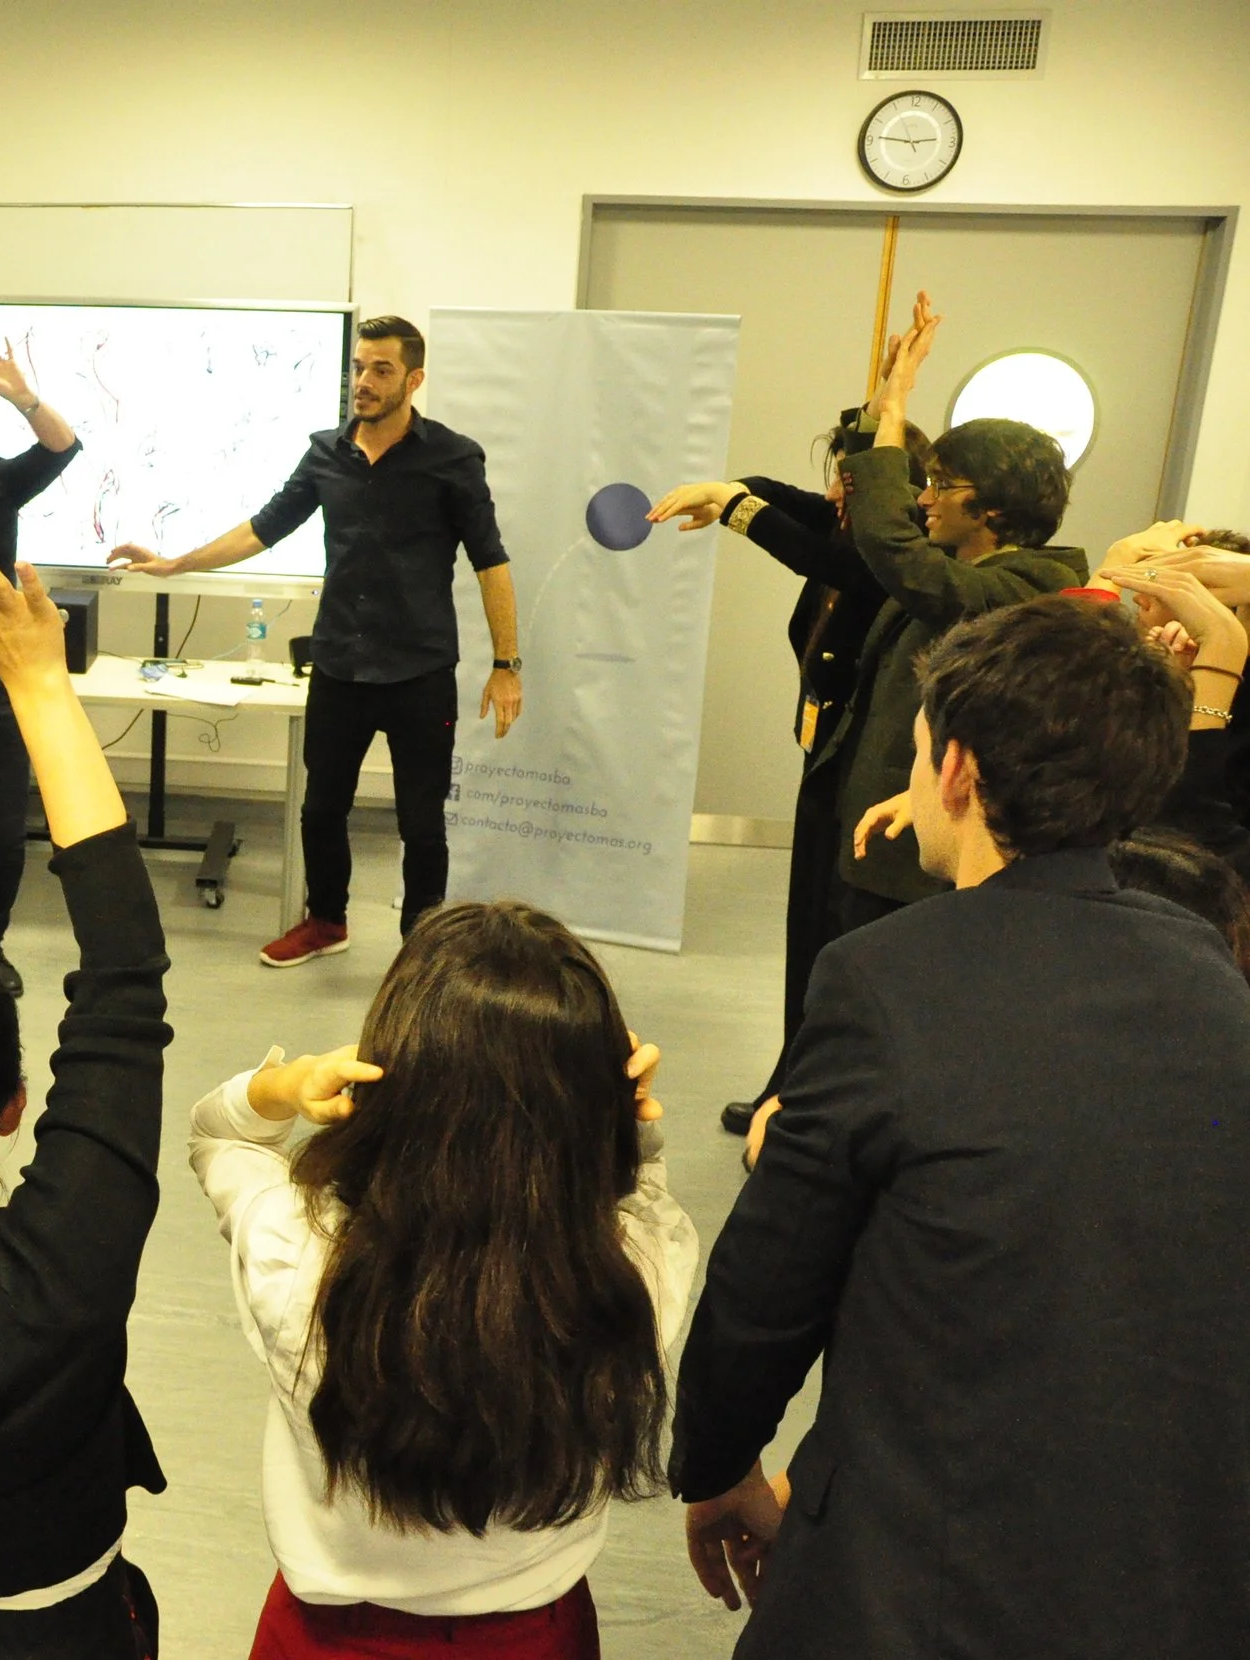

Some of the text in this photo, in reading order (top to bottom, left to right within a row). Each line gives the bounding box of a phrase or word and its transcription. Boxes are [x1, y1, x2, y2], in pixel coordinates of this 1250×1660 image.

[911, 96, 921, 107] 12
[866, 135, 874, 147] 9
[949, 137, 956, 148] 3
[902, 174, 910, 186] 6
[464, 762, 571, 785] proyectomasba
[460, 816, 652, 856] contacto@proyectomas.org
